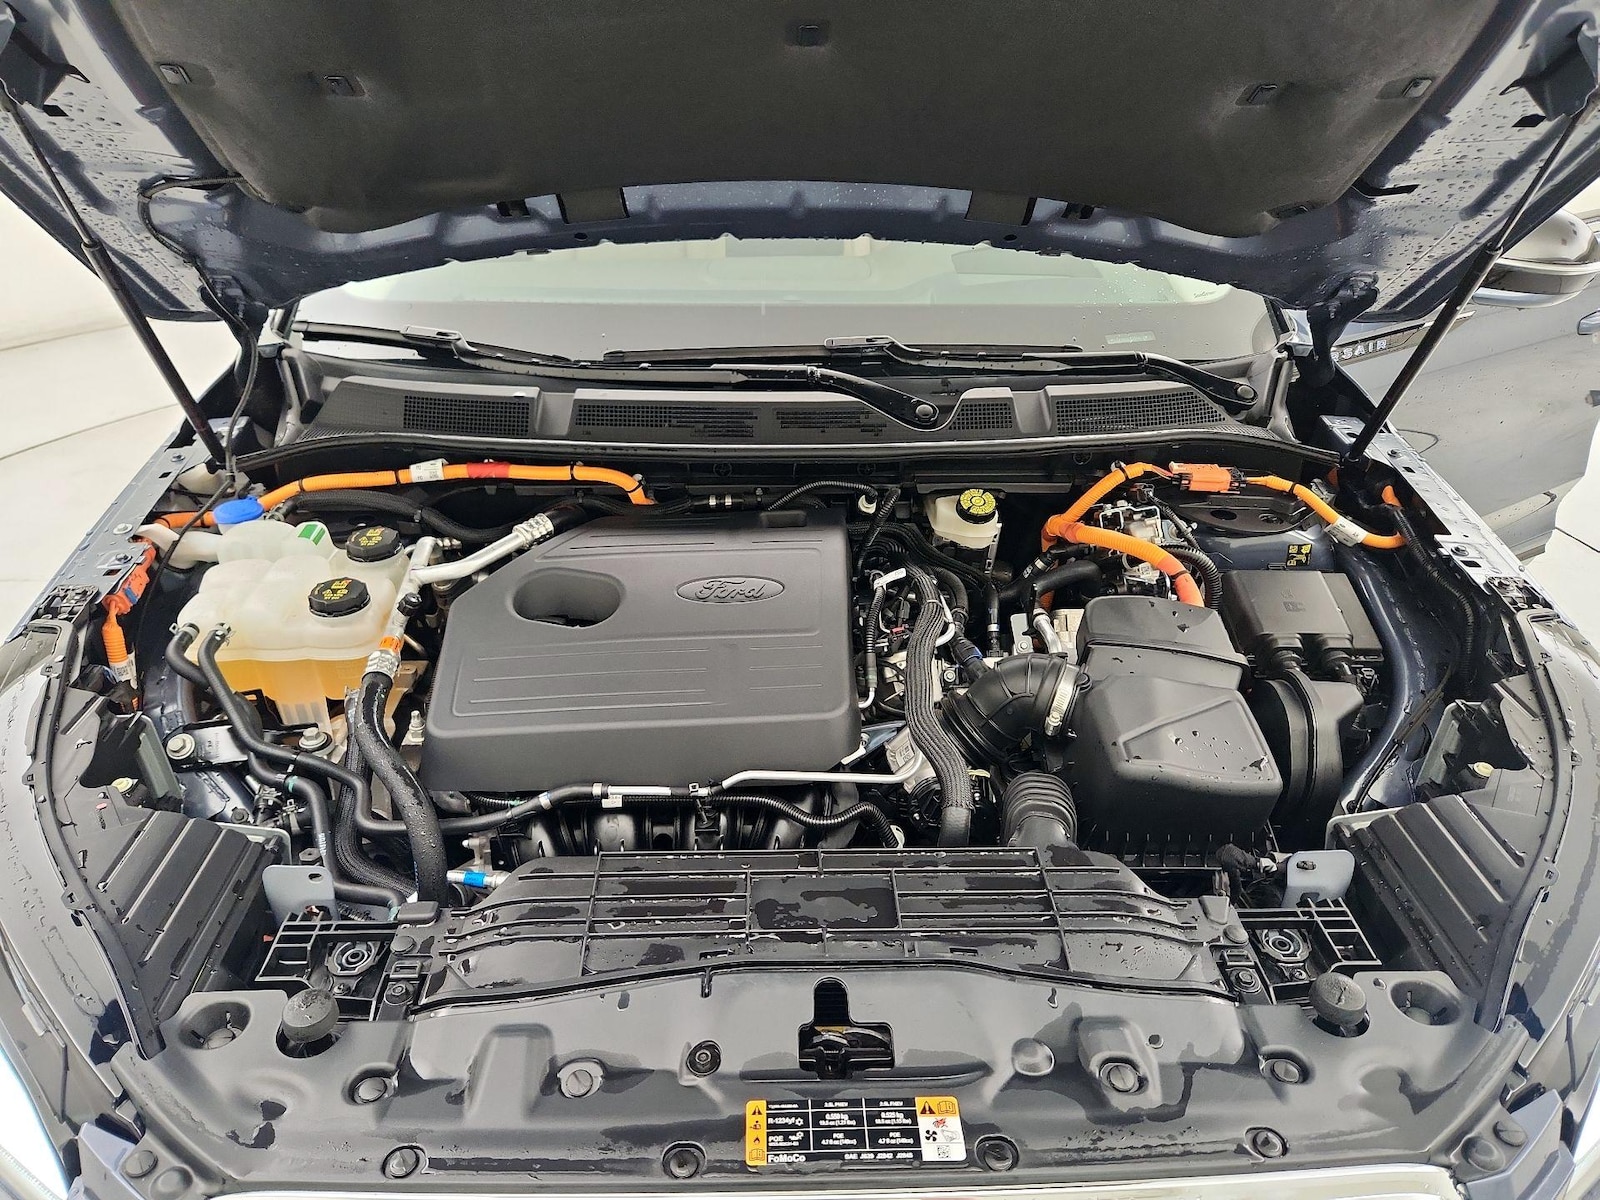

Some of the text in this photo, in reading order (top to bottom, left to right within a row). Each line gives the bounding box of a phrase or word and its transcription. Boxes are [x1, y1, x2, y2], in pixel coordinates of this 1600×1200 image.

[694, 580, 767, 600] Ford
[768, 1117, 795, 1125] R-1234yf
[768, 1153, 806, 1163] FoMoCo
